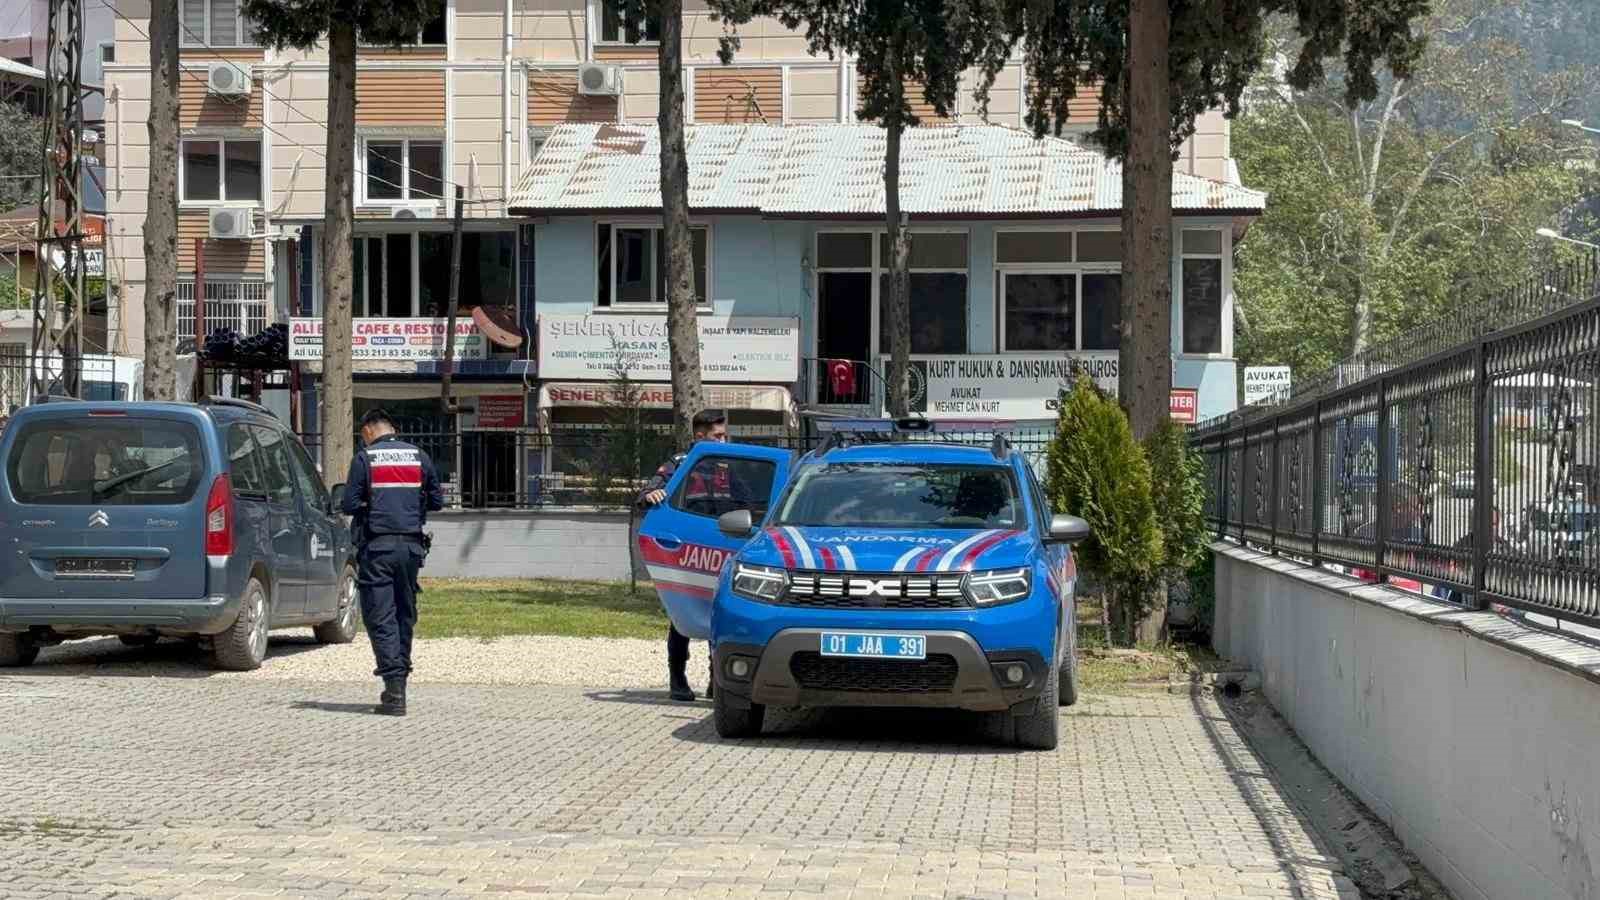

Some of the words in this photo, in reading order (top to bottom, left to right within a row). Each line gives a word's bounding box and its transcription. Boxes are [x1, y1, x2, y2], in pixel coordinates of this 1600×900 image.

[357, 324, 389, 334] CAFE
[393, 324, 401, 334] &
[405, 324, 479, 334] RESTOANT
[618, 320, 670, 336] TİCA
[929, 360, 955, 378] KURT
[959, 360, 994, 378] HUKUK
[996, 361, 1005, 378] &
[1083, 355, 1118, 378] BÜROS
[1247, 371, 1289, 380] AVUKAT
[951, 387, 981, 398] AVUKAT
[935, 401, 963, 412] MEHMET
[966, 401, 980, 412] CAN
[982, 401, 1000, 412] KURT
[809, 535, 956, 545] JANDARMA
[830, 635, 846, 653] 01
[857, 636, 883, 654] JAA
[899, 638, 923, 656] 391
